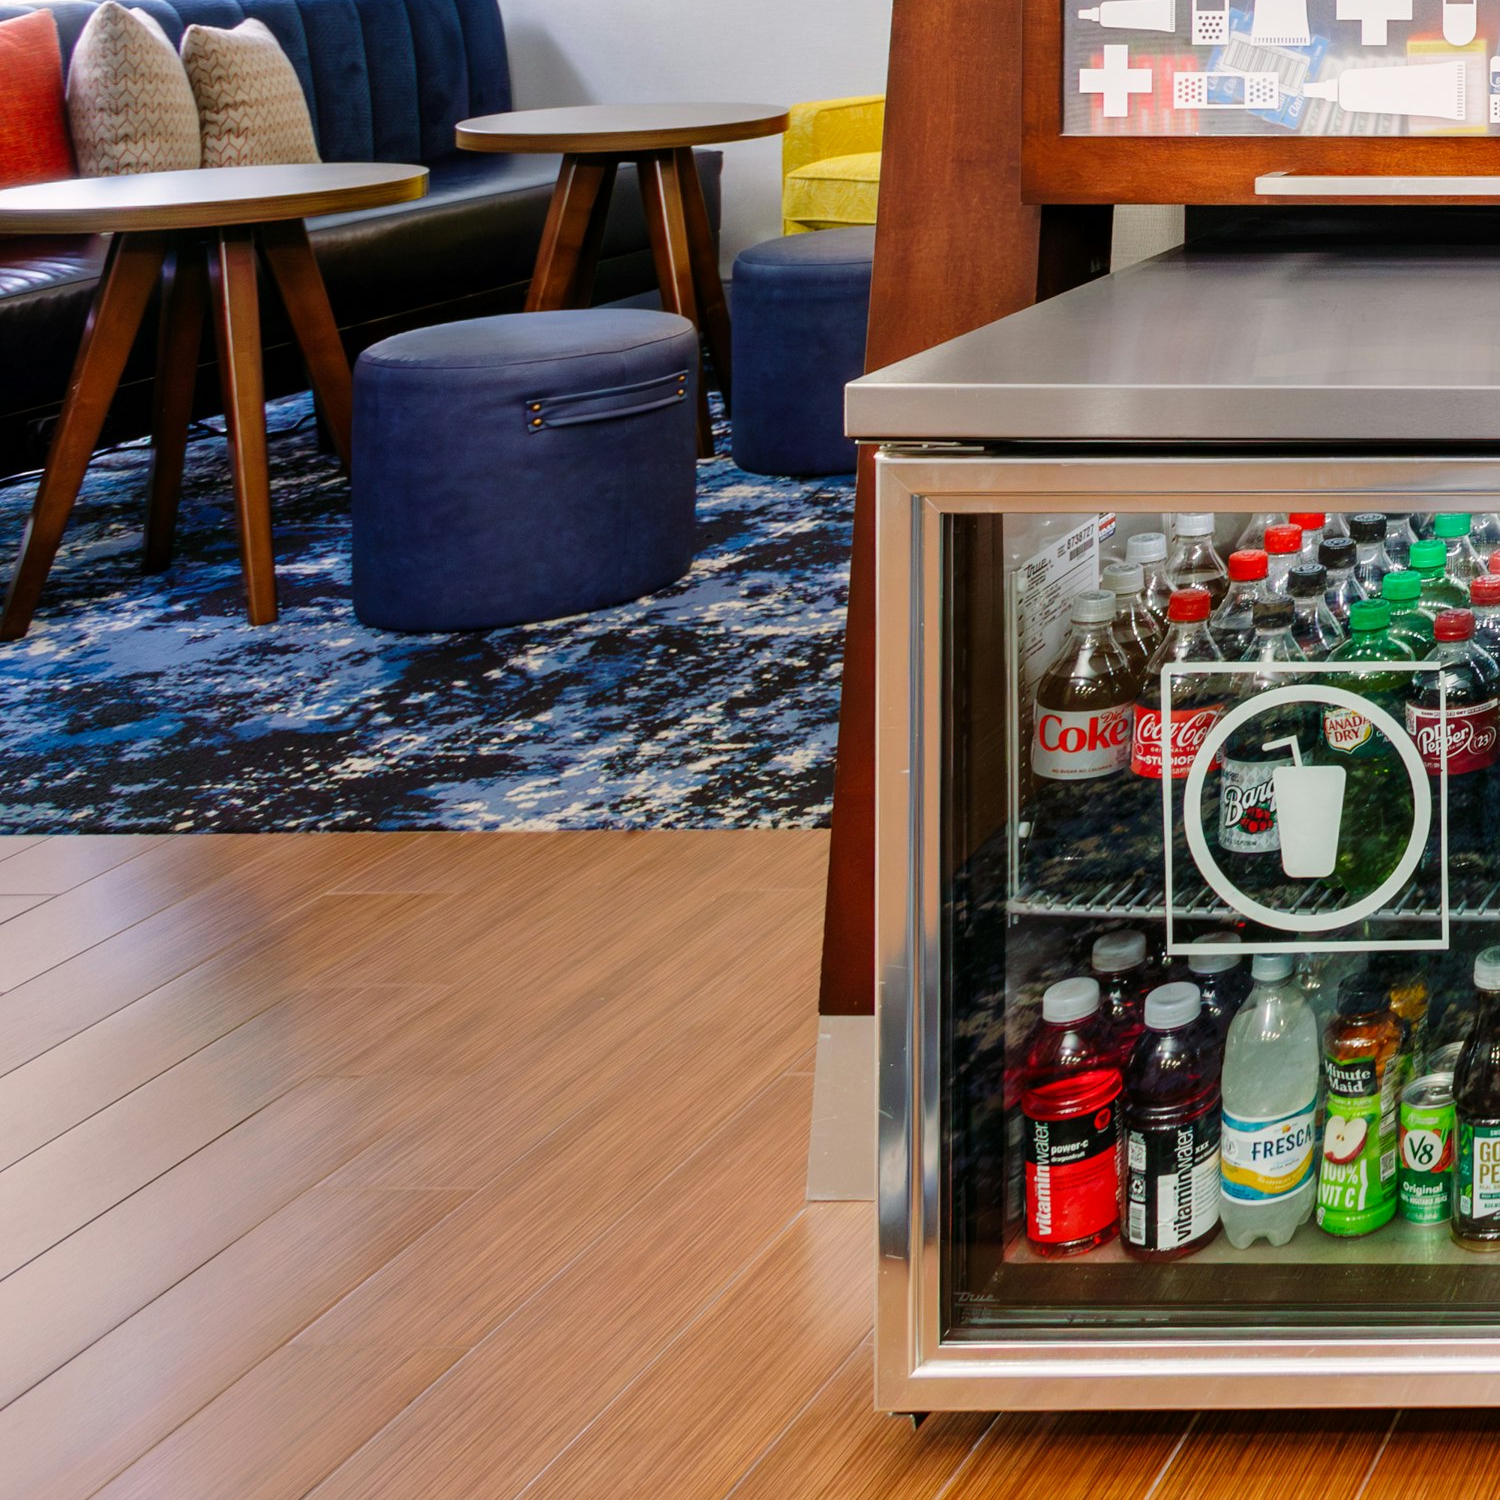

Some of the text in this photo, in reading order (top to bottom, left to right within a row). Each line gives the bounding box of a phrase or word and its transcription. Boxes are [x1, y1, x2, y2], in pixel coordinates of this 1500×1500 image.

[1039, 714, 1129, 753] Coke
[1335, 725, 1360, 743] DRY
[1325, 1060, 1371, 1080] Minute
[1328, 1075, 1364, 1093] Maid
[1251, 1125, 1312, 1162] FRESCA
[1409, 1135, 1434, 1165] V8
[1032, 1121, 1051, 1236] vitaminwater
[1173, 1126, 1193, 1242] vitaminwater
[1322, 1163, 1359, 1185] 100%
[1403, 1181, 1442, 1196] Original
